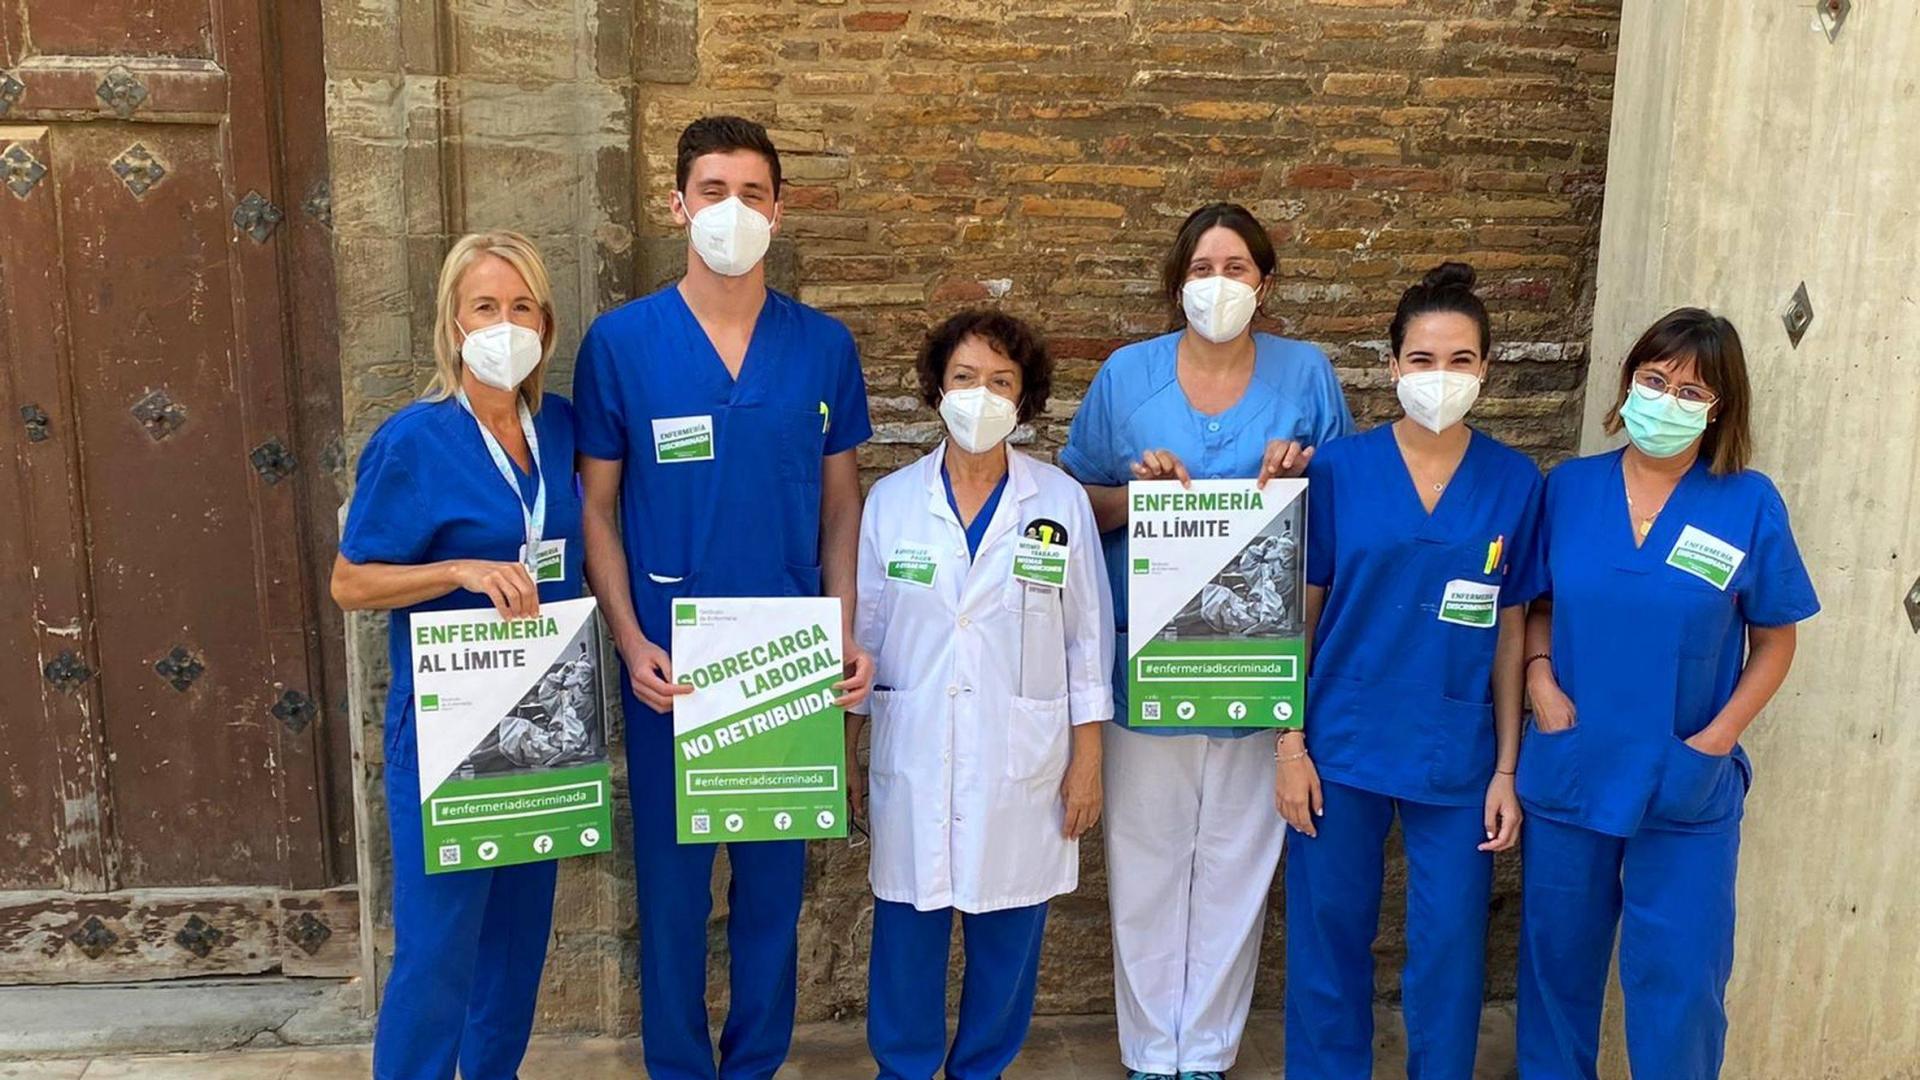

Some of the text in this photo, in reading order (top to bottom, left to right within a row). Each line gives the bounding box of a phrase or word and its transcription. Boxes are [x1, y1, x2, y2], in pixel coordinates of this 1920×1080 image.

[1133, 489, 1264, 511] ENFERMERÍA
[1133, 517, 1230, 538] AL LÍMITE
[416, 616, 559, 645] ENFERMERÍA
[418, 649, 526, 673] AL LÍMITE
[677, 623, 829, 689] SOBRECARGA
[740, 647, 841, 699] LABORAL
[680, 688, 838, 761] NO RETRIBUIDA
